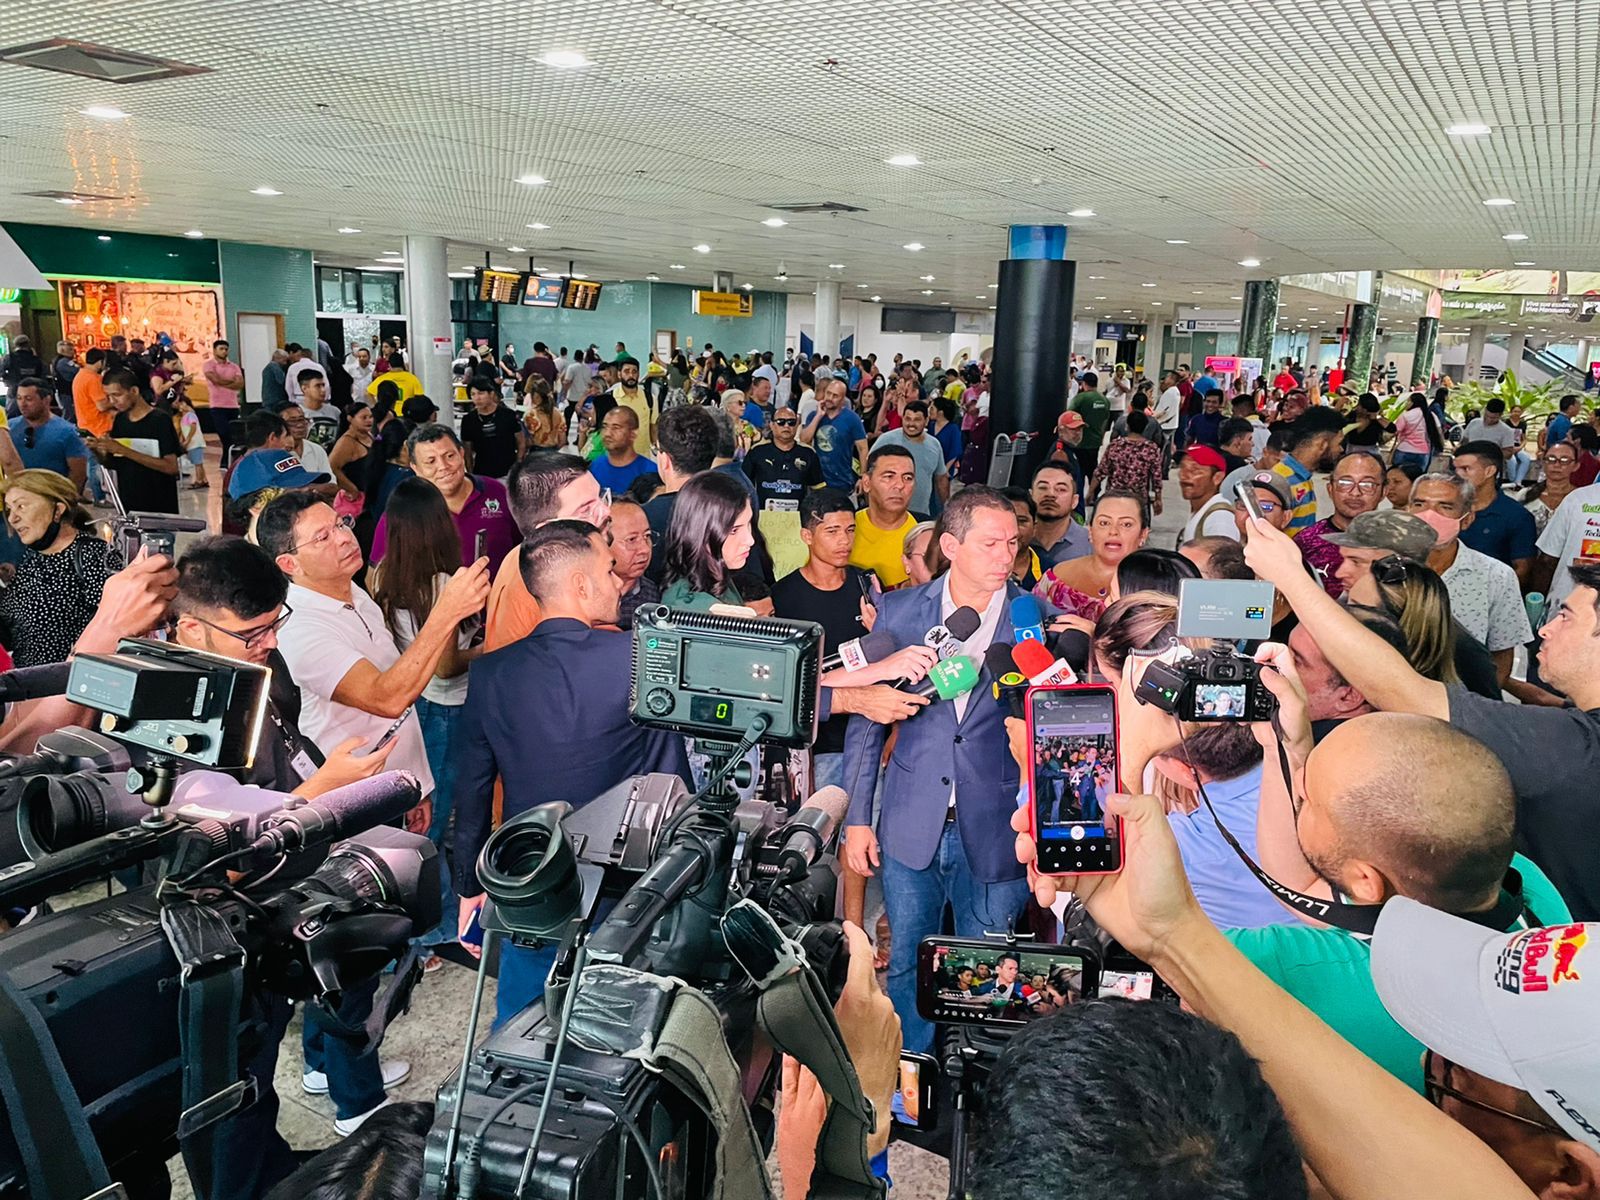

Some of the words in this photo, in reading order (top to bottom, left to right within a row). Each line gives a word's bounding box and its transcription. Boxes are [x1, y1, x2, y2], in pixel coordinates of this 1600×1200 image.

[716, 703, 728, 719] 0
[1070, 772, 1081, 786] 4
[1259, 872, 1331, 917] LUMIX
